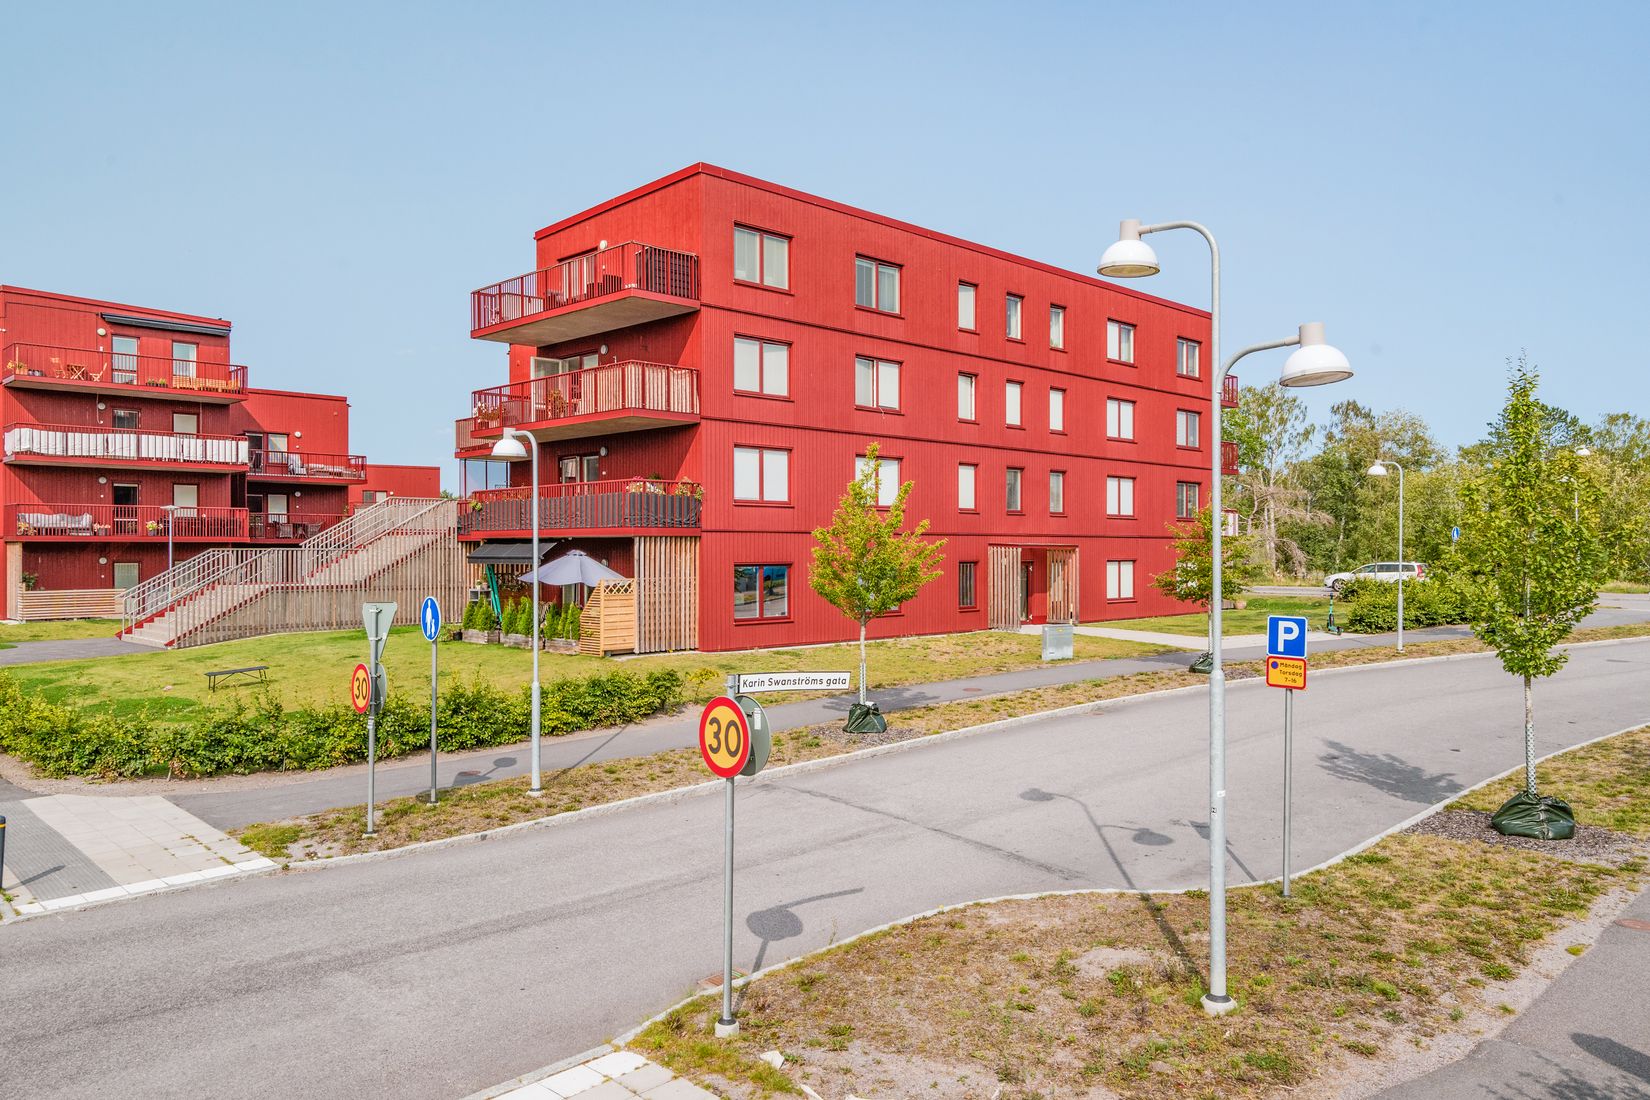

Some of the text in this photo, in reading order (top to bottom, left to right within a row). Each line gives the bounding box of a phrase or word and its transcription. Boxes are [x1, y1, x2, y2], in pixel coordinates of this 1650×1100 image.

[1278, 621, 1299, 652] P
[355, 677, 367, 700] 30
[743, 677, 847, 688] Karin Swanströms gata
[708, 717, 741, 758] 30
